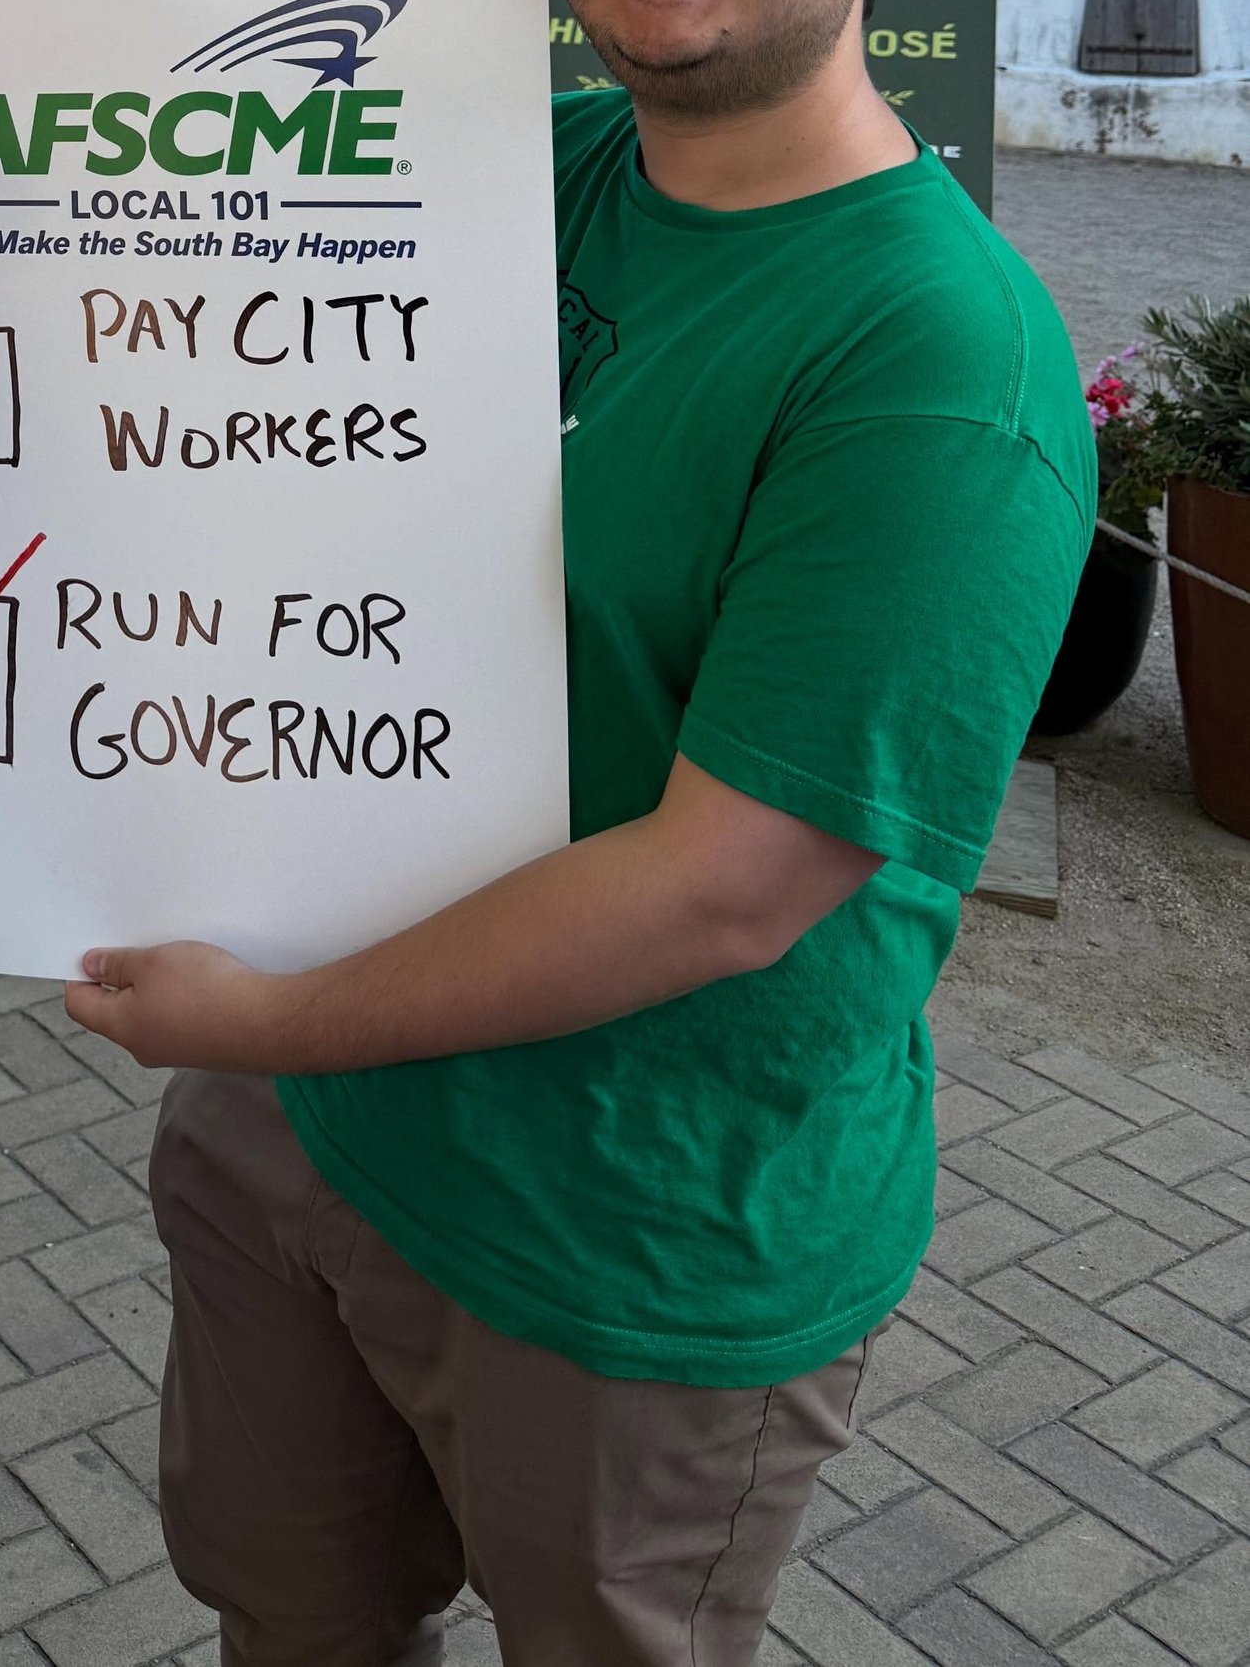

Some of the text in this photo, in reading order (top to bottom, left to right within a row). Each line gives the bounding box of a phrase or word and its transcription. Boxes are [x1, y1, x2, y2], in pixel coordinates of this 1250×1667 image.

[868, 22, 958, 60] OSÉ
[71, 190, 268, 220] LOCAL 101
[79, 231, 125, 255] the
[134, 231, 222, 256] South
[232, 232, 290, 263] Bay
[297, 233, 416, 264] Happen
[80, 289, 428, 365] PAY CITY
[100, 403, 426, 471] WORKERS
[57, 579, 406, 664] RUN FOR
[70, 683, 450, 782] GOVERNOR
